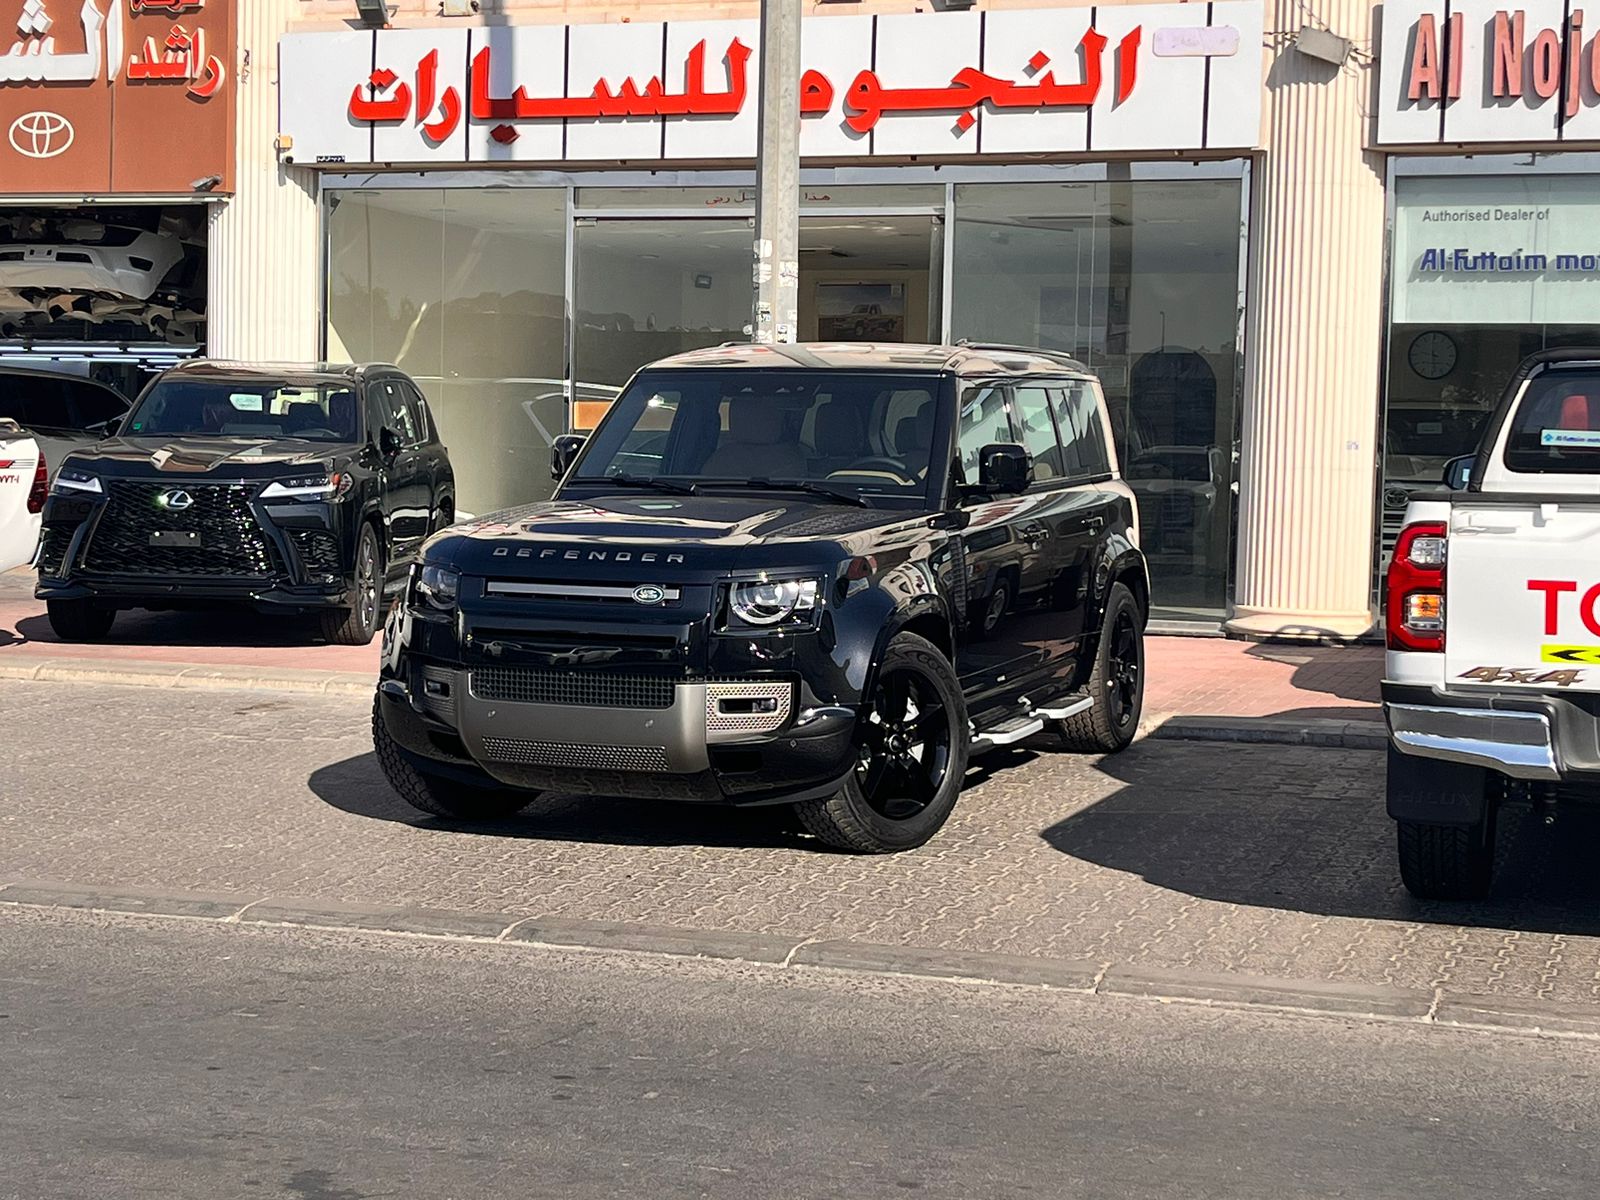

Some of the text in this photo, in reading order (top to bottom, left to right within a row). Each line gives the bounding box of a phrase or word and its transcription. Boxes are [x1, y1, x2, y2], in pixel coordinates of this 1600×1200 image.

[128, 24, 224, 97] راشد
[1408, 12, 1463, 99] Al
[348, 36, 752, 143] للسيارات
[1422, 207, 1550, 222] Authorised Dealer of
[1420, 248, 1546, 270] Al-Futtaim
[493, 547, 684, 563] DEFENDER
